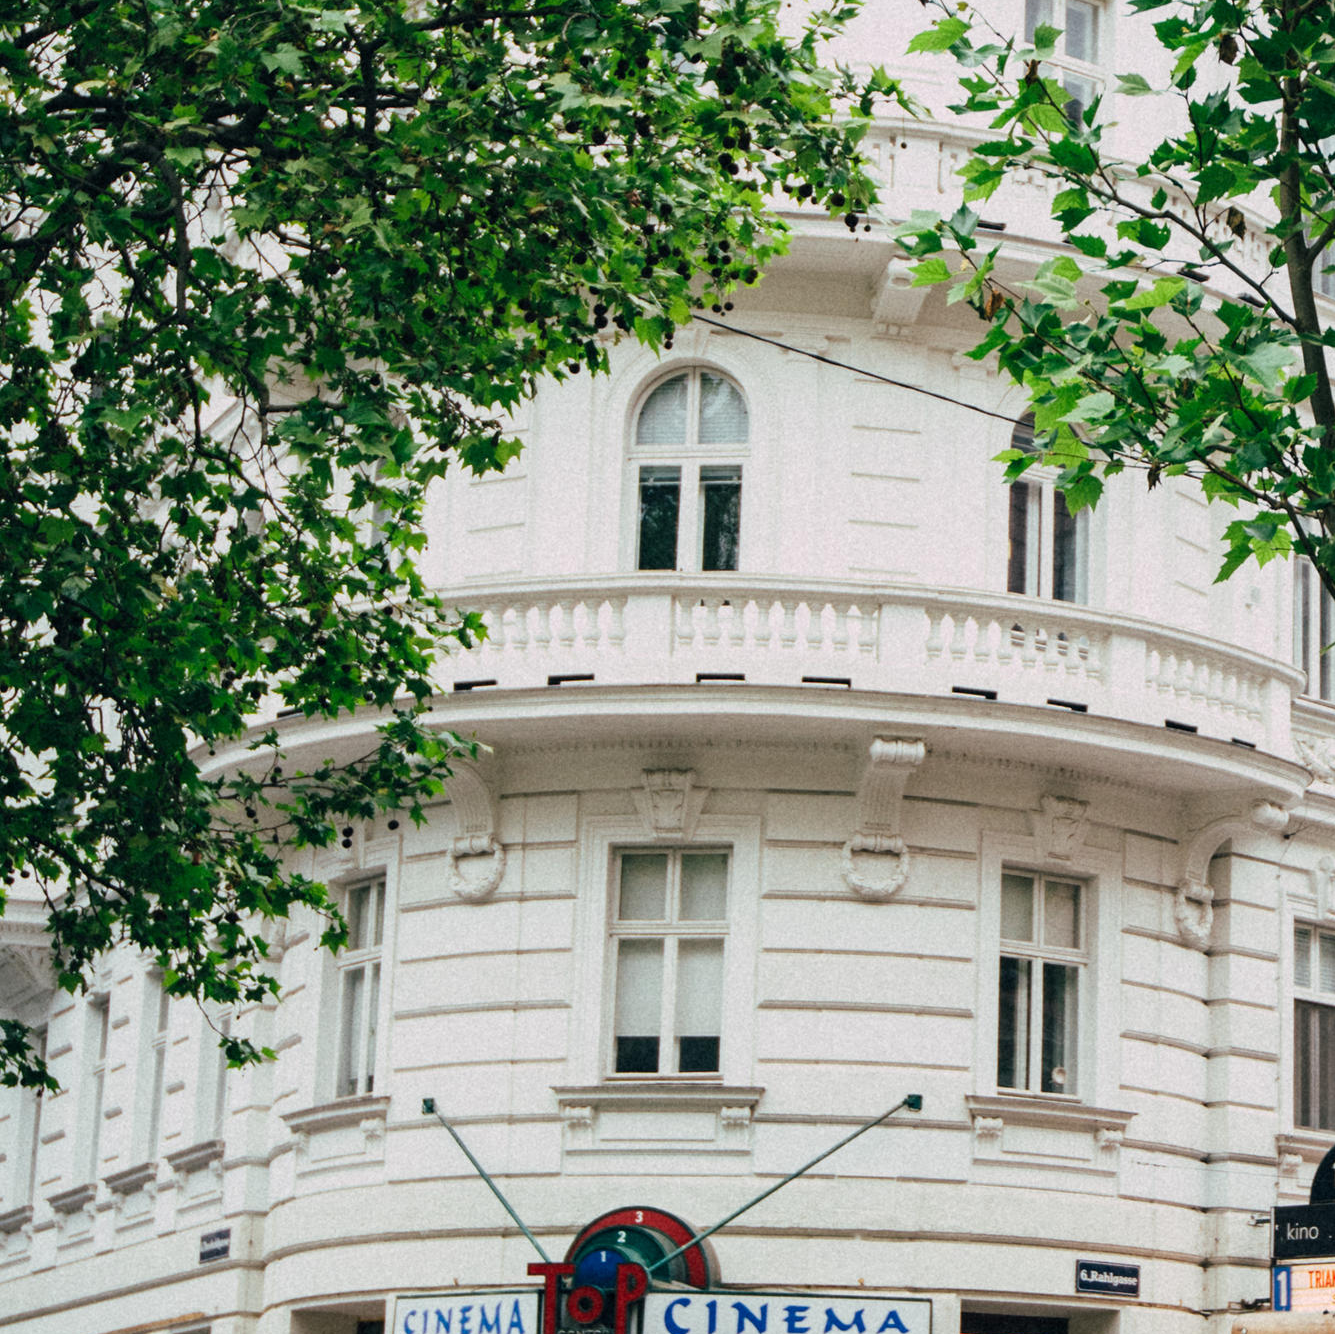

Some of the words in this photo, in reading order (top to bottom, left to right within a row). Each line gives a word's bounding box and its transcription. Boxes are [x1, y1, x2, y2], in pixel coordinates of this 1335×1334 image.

[635, 1211, 643, 1223] 3
[617, 1230, 627, 1243] 2
[1287, 1222, 1320, 1240] kino
[600, 1251, 607, 1262] 1
[1277, 1270, 1288, 1306] 1
